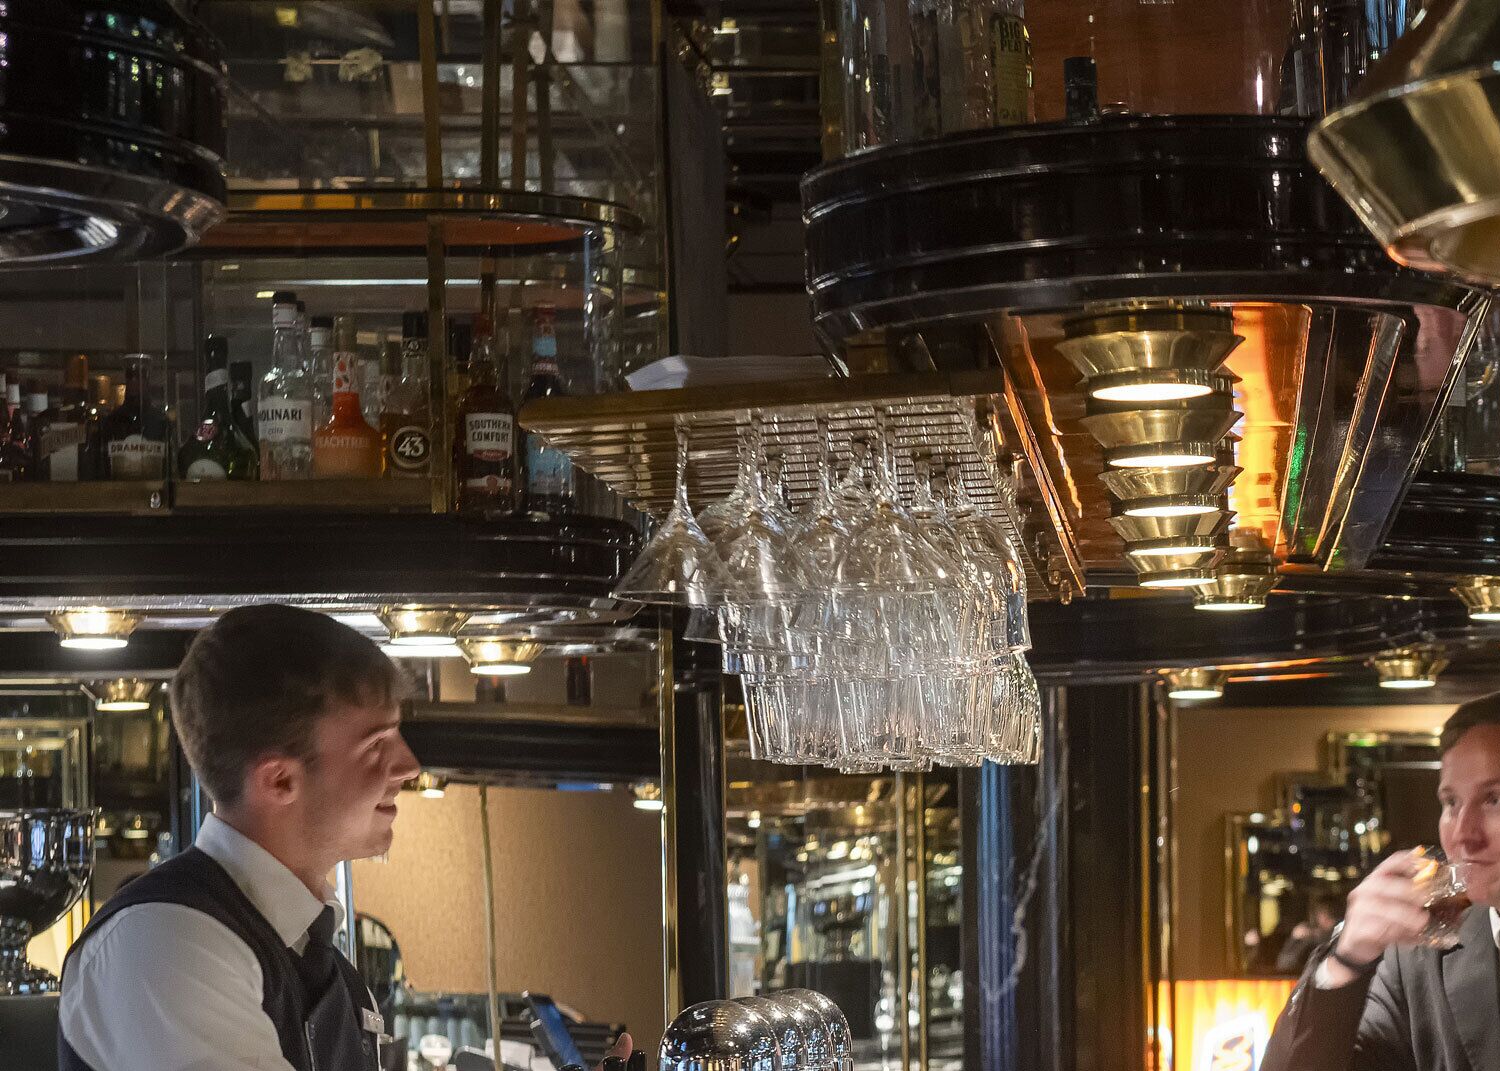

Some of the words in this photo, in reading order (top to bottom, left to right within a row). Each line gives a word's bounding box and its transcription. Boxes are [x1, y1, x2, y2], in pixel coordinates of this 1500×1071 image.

[1000, 21, 1020, 39] BIG
[472, 432, 509, 443] COMFORT
[398, 437, 424, 457] 43
